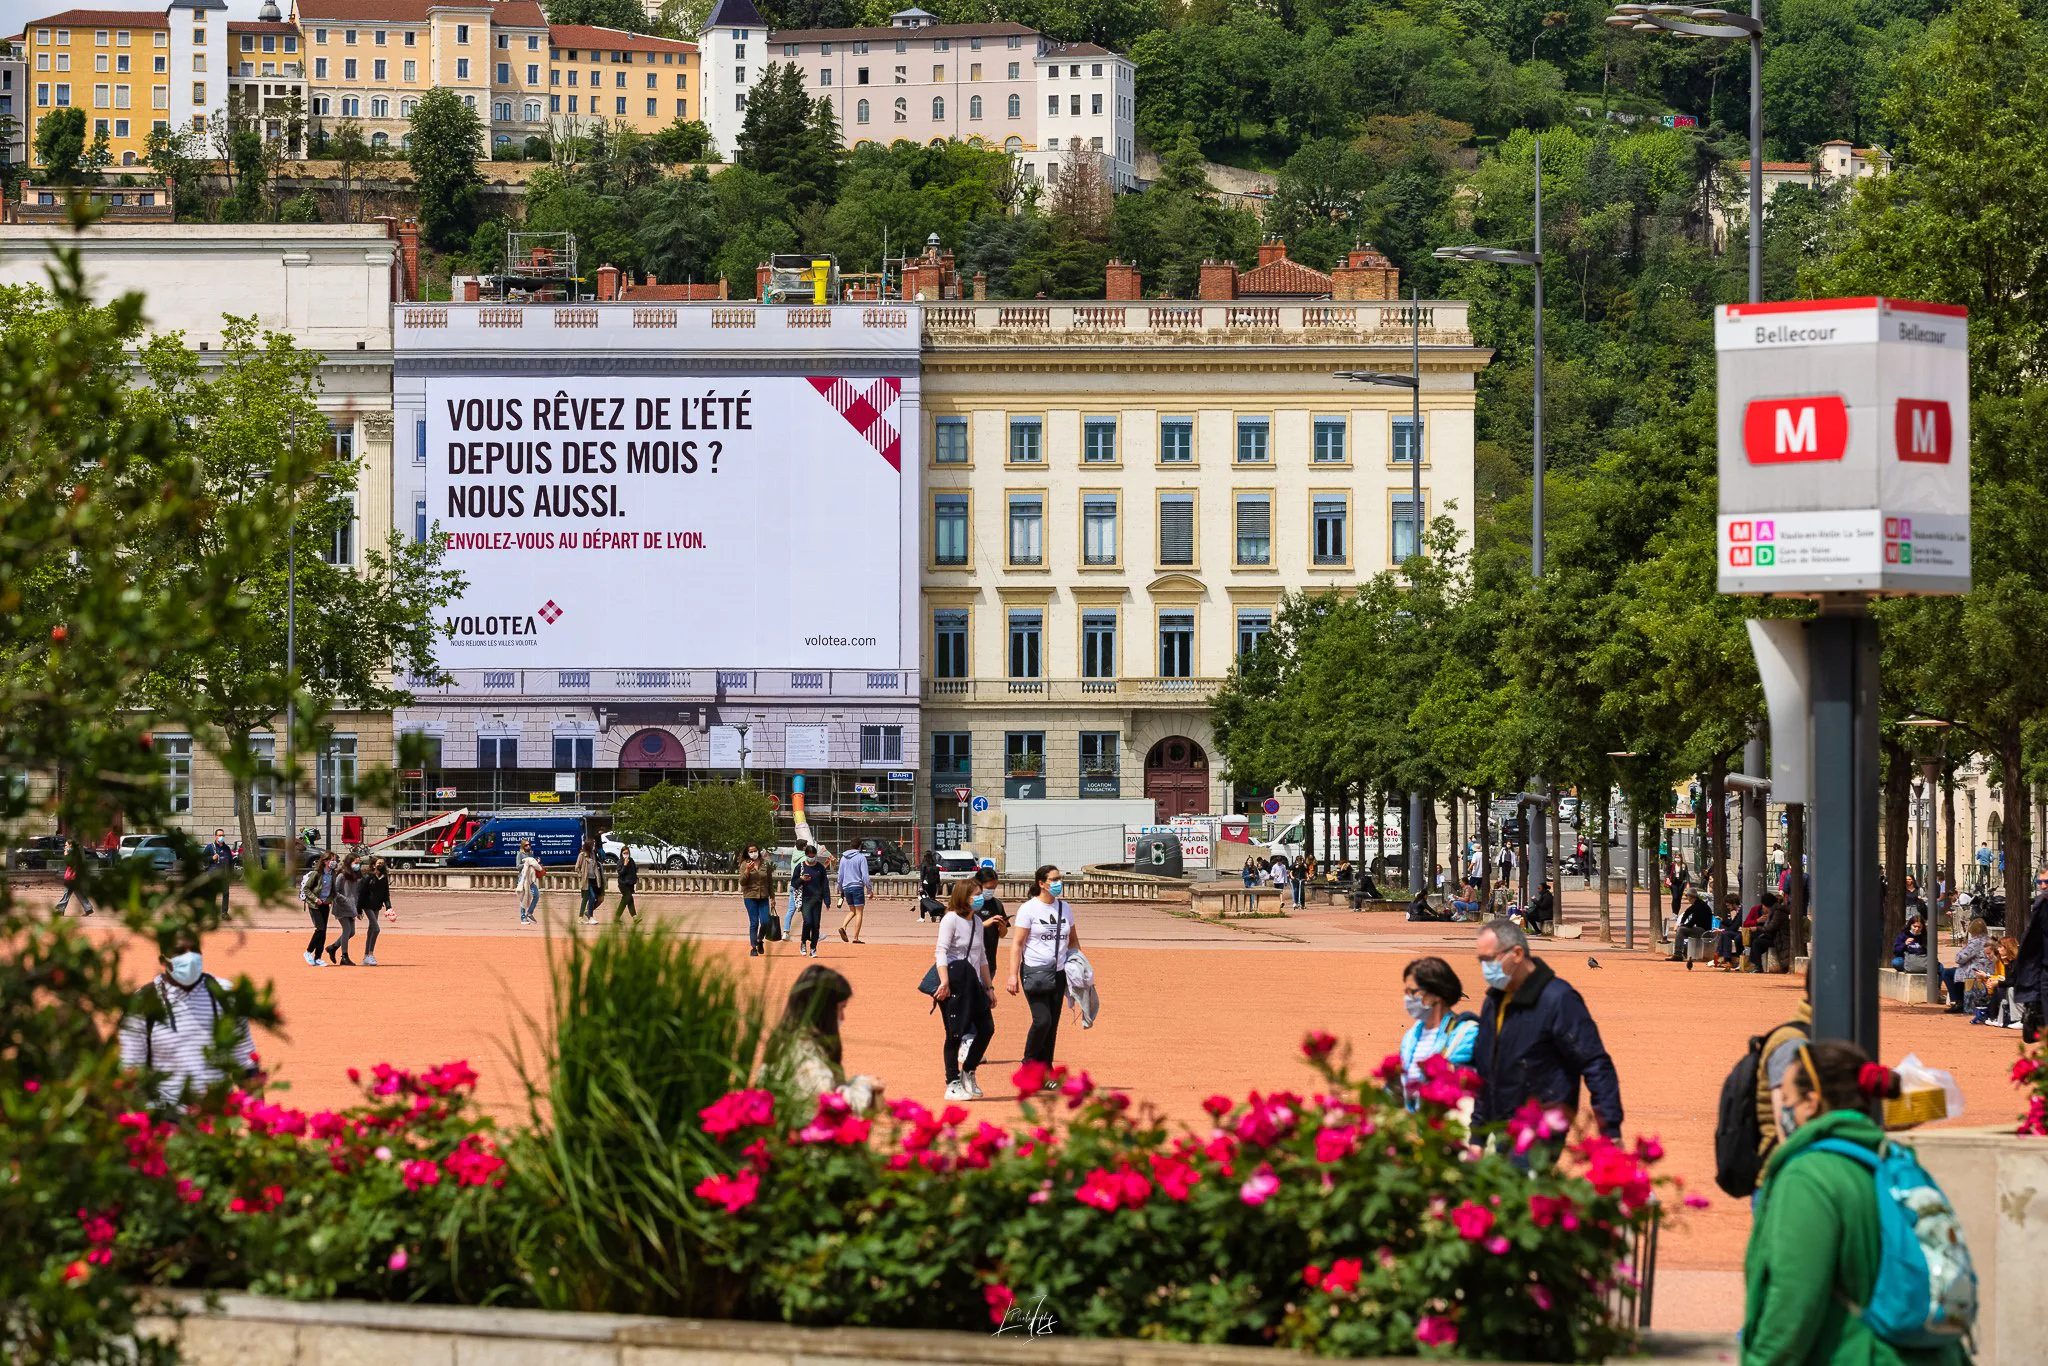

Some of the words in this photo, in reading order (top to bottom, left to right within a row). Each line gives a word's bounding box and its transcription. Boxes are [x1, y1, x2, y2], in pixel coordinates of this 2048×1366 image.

[1755, 325, 1837, 344] Bellecour
[1899, 322, 1947, 345] Bellecour
[447, 398, 523, 432] VOUS
[533, 390, 625, 431] RÊVEZ
[635, 398, 671, 431] DE
[682, 390, 753, 430] L'ÉTÉ
[1775, 406, 1817, 454] M
[1911, 408, 1937, 455] M
[448, 441, 553, 475] DEPUIS
[562, 441, 617, 474] DES
[627, 440, 698, 474] MOIS
[708, 440, 723, 474] ?
[448, 484, 525, 519] NOUS
[533, 484, 626, 518] AUSSI.
[447, 532, 557, 550] ENVOLEZ-VOUS
[559, 532, 577, 549] AU
[582, 528, 639, 549] DÉPART
[643, 532, 662, 549] DE
[667, 532, 707, 549] LYON.
[1733, 523, 1750, 540] M
[1758, 523, 1773, 539] A
[1733, 548, 1750, 564] M
[1758, 547, 1773, 563] D
[446, 616, 538, 636] VOLOTEA
[451, 639, 465, 647] NOUS
[465, 639, 487, 647] RELIONS
[487, 639, 497, 647] LES
[498, 639, 515, 647] VILLES
[515, 638, 538, 647] VOLOTEA
[804, 634, 877, 648] volotea.com
[1186, 846, 1195, 855] et
[1196, 845, 1209, 855] Cie
